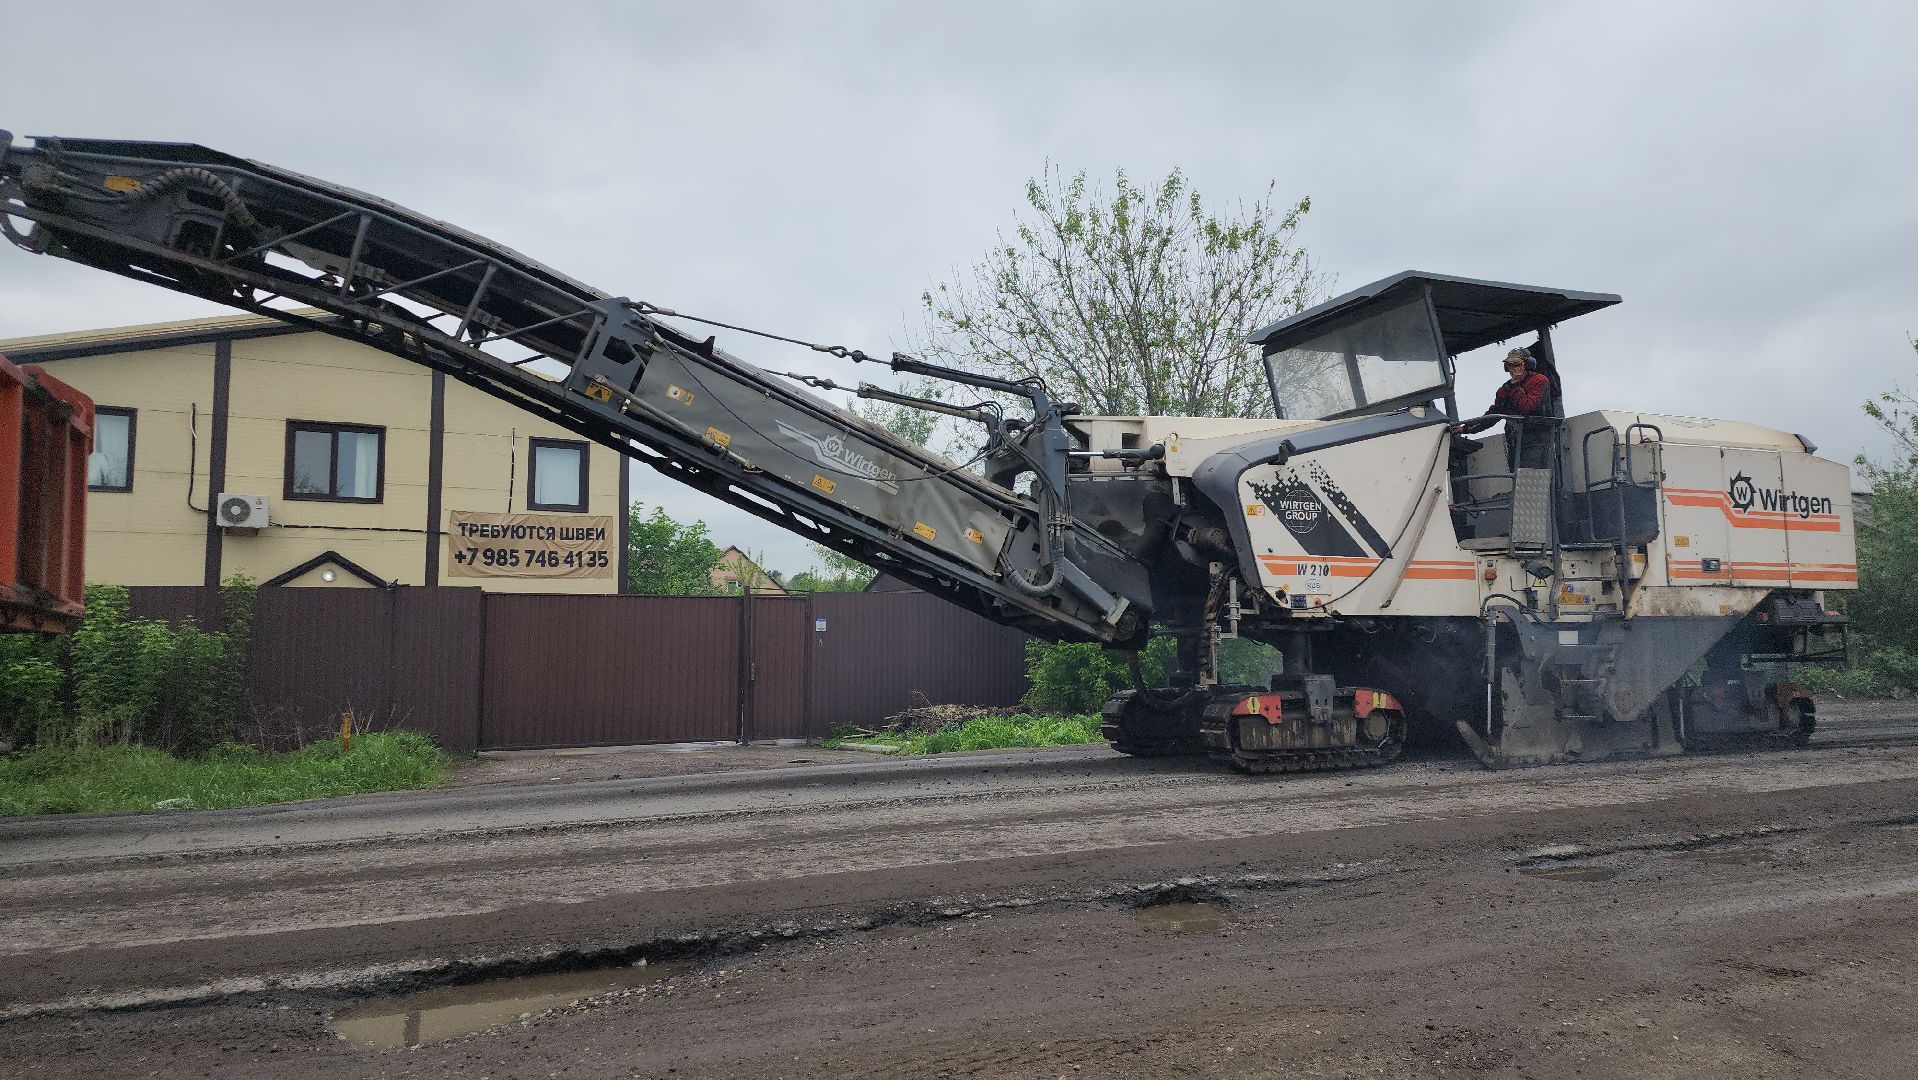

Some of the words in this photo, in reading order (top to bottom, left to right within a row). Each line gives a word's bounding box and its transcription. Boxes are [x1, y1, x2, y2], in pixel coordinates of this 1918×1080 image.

[845, 449, 897, 480] Wirtgen
[1736, 486, 1748, 501] W
[1280, 500, 1322, 511] WIRTGEN
[1759, 488, 1832, 519] Wirtgen
[1285, 511, 1318, 521] GROUP
[458, 522, 555, 541] ТРЕБУЮТСЯ
[560, 526, 605, 541] ШВЕИ
[454, 547, 479, 565] +7
[483, 547, 520, 567] 985
[525, 549, 560, 568] 746
[1297, 563, 1308, 576] W
[1310, 564, 1330, 577] 210
